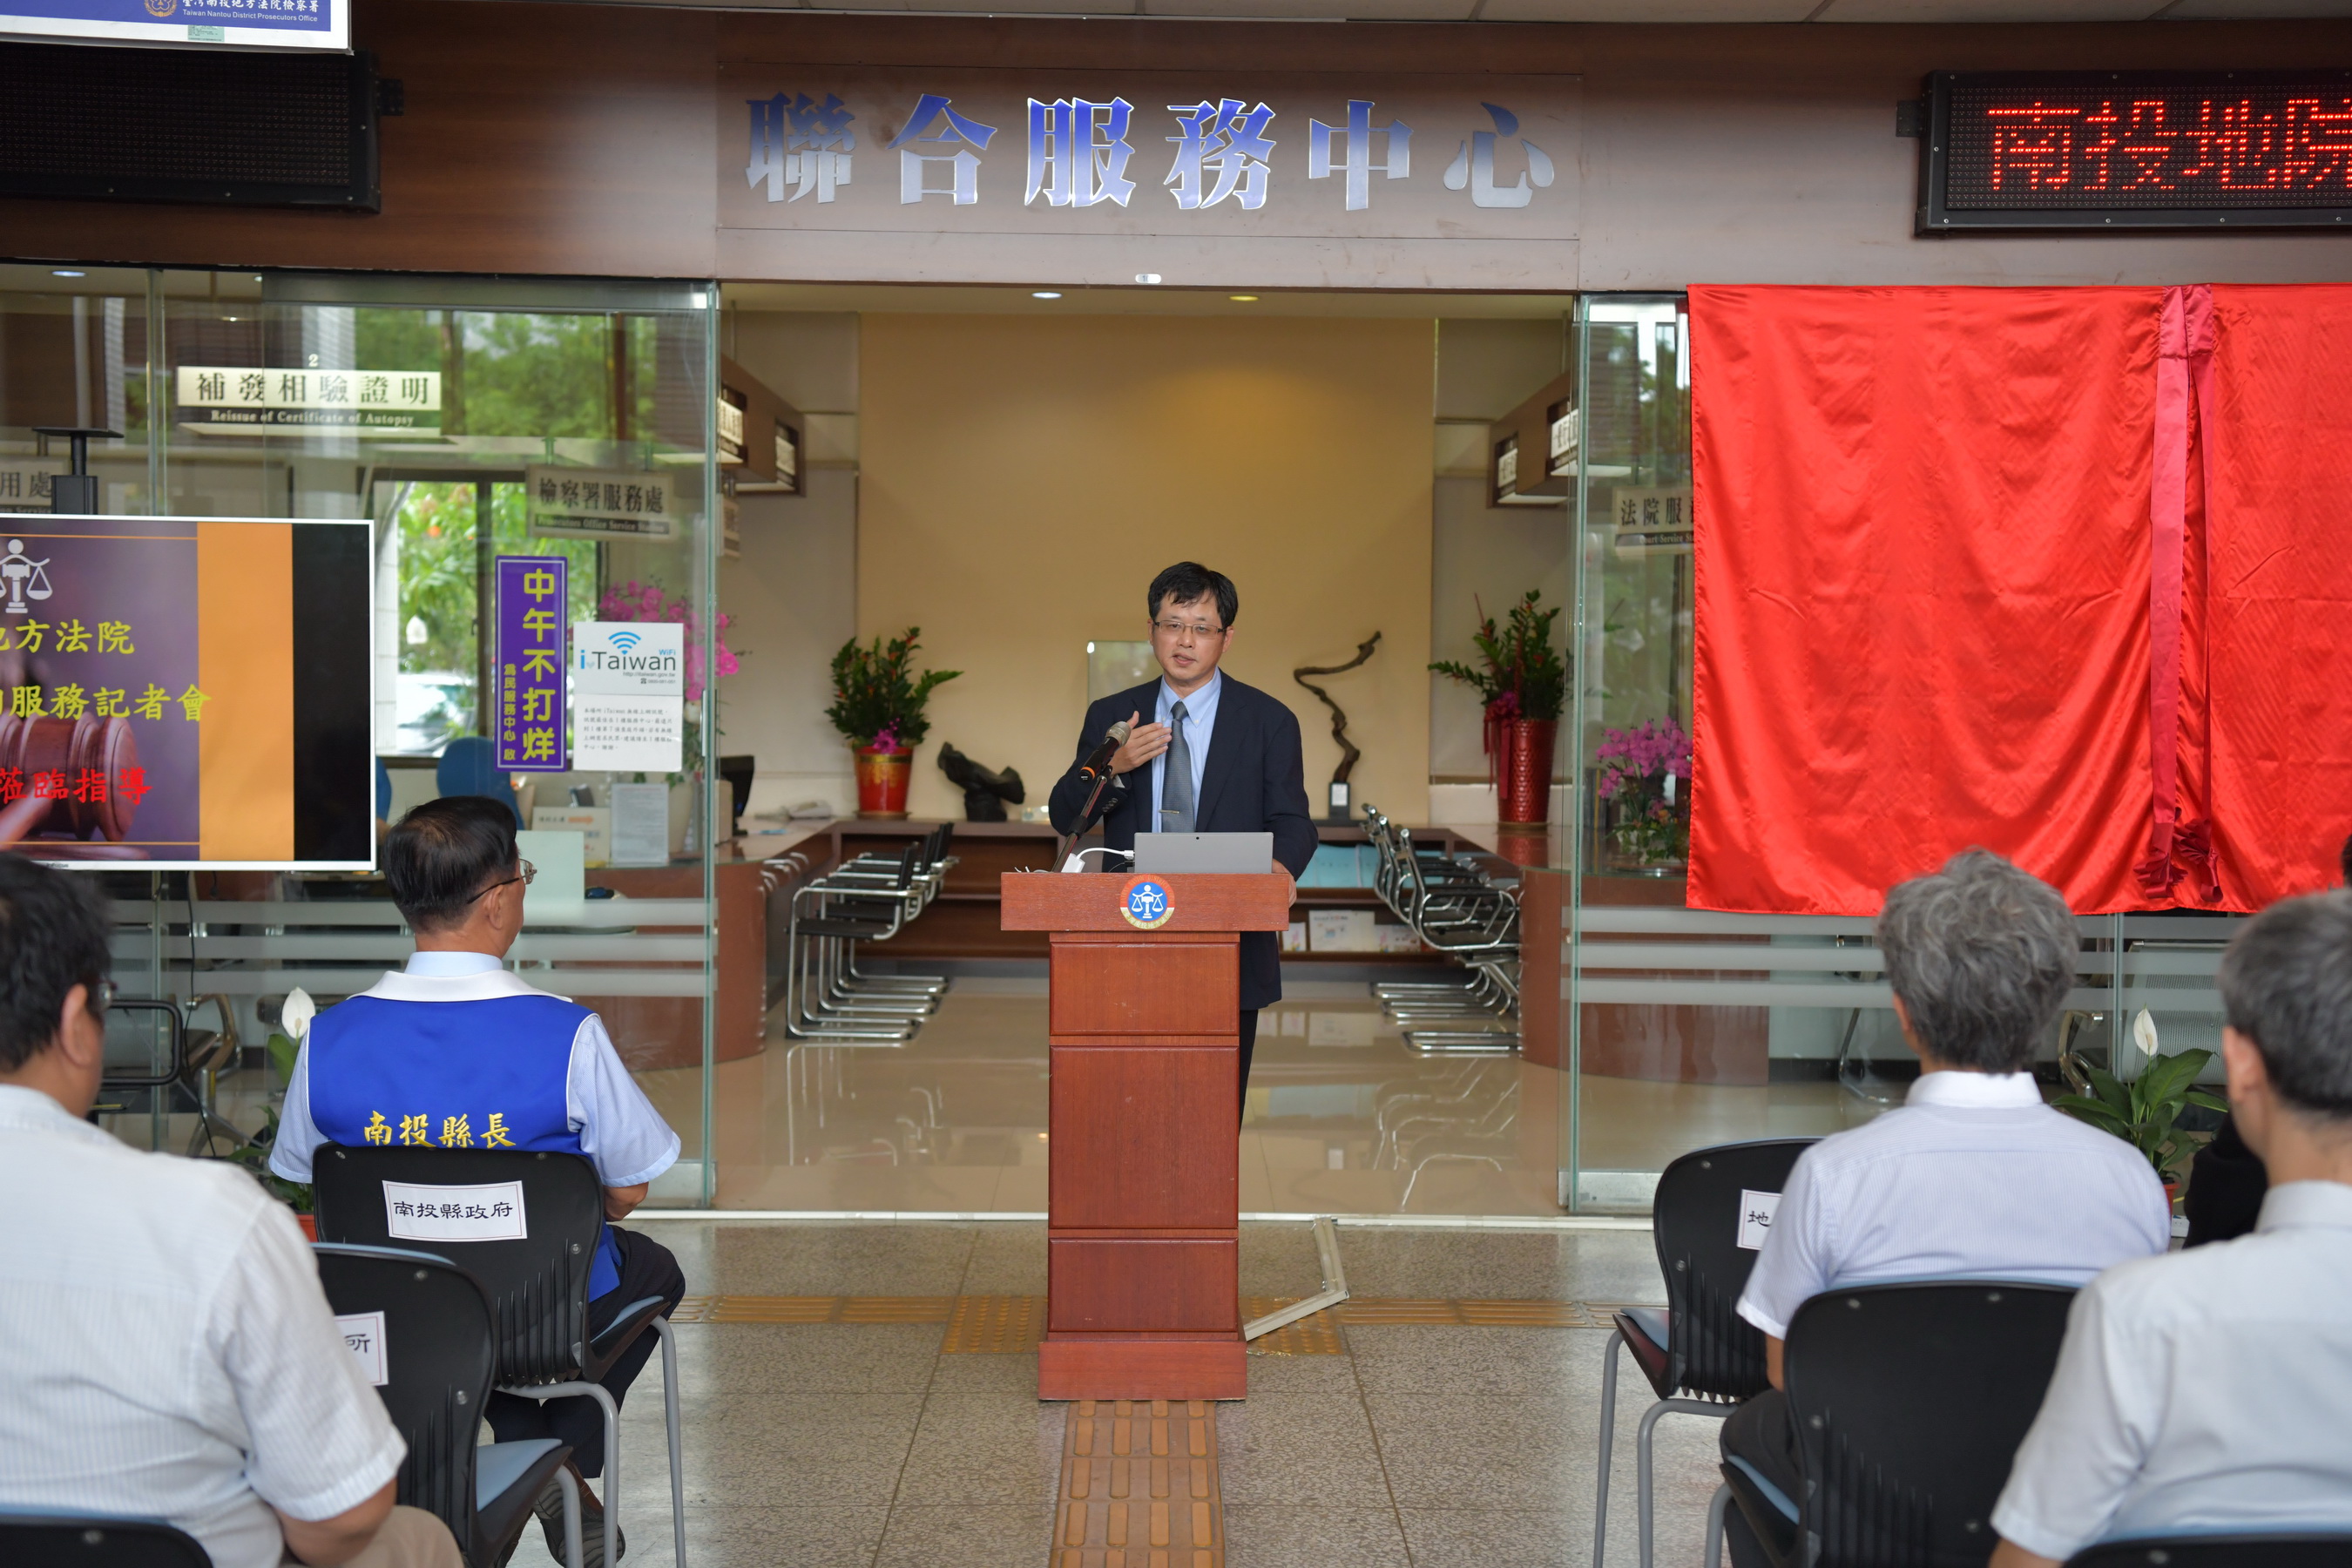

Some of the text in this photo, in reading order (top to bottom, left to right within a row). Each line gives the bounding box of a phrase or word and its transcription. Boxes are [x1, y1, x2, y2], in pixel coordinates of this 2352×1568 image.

[745, 92, 1555, 211] 聯合服務中心
[1988, 98, 2352, 190] 南投地院
[308, 354, 319, 367] 2
[196, 373, 429, 405] 補發相驗證明
[211, 410, 414, 427] Reissue of Certificate of Autopsy
[538, 478, 664, 513] 檢察署服務處
[1660, 533, 1683, 544] Service
[523, 568, 556, 761] 中午不打烊
[0, 683, 213, 722] 服務記者會
[364, 1110, 516, 1148] 南投縣長
[393, 1201, 513, 1220] 南投縣政府
